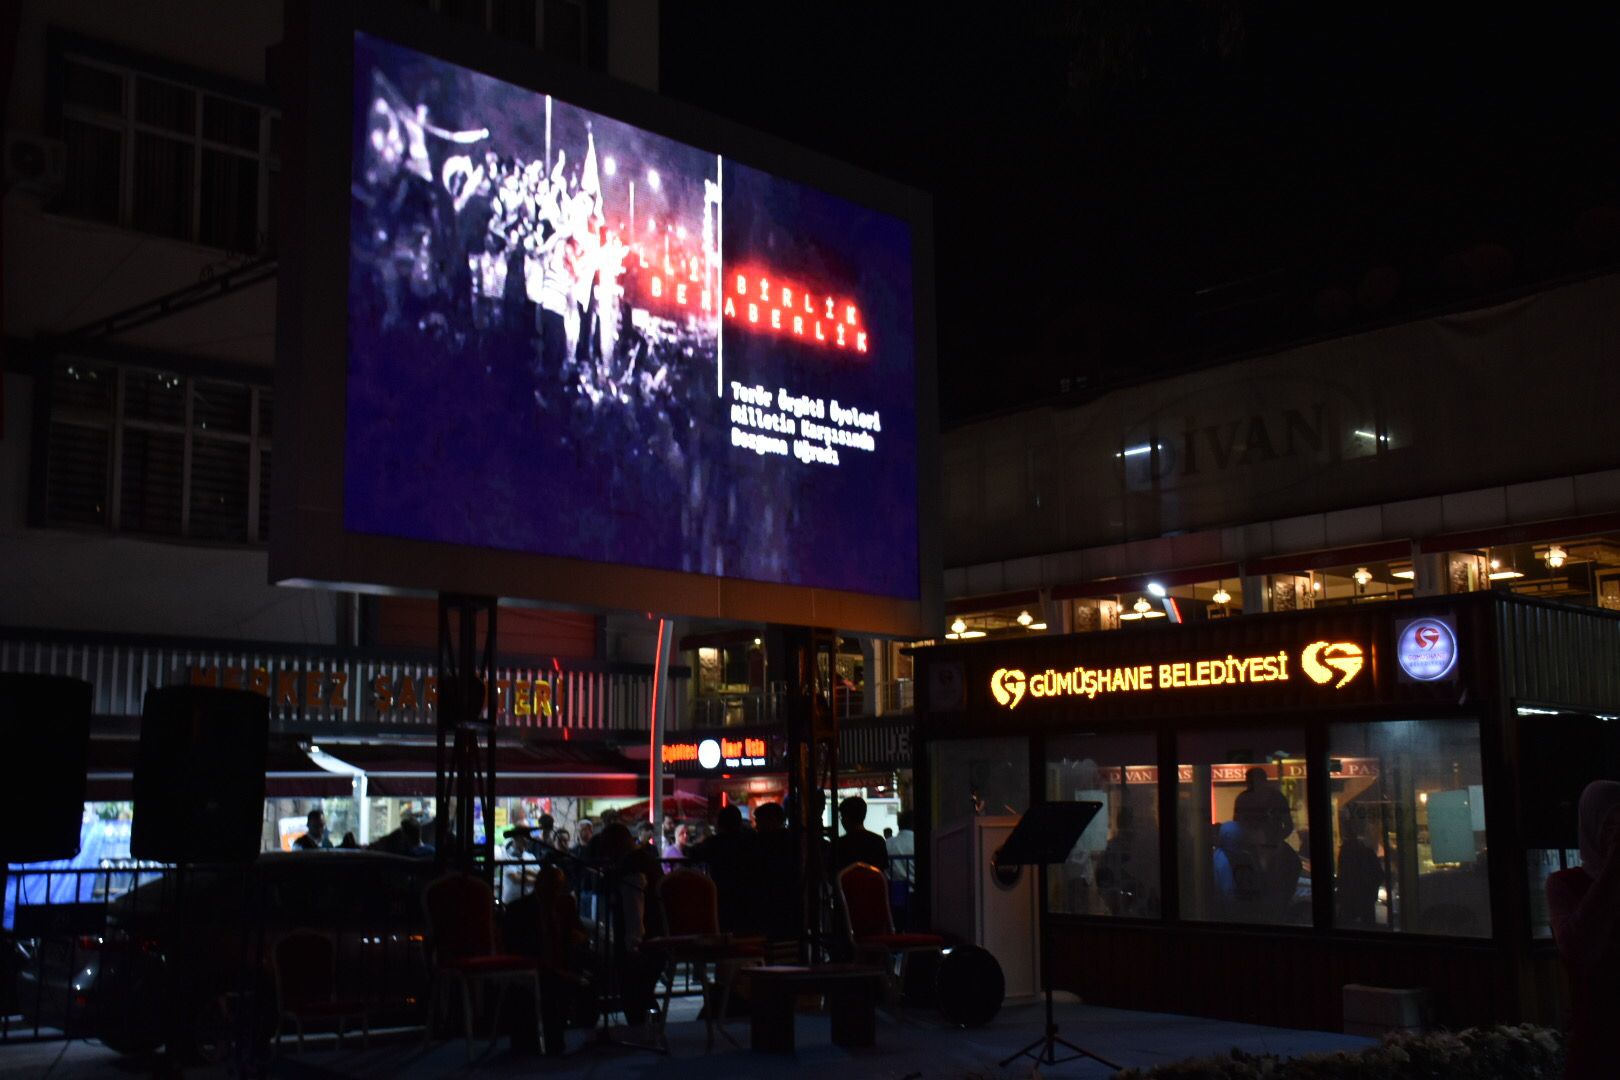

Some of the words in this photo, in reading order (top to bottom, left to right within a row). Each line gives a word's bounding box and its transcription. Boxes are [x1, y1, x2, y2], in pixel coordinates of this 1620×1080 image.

[736, 273, 857, 325] BİRLİK
[731, 404, 796, 435] Milletin
[1029, 666, 1153, 699] GÜMÜŞHANE
[1159, 650, 1289, 689] BELEDİYESİ
